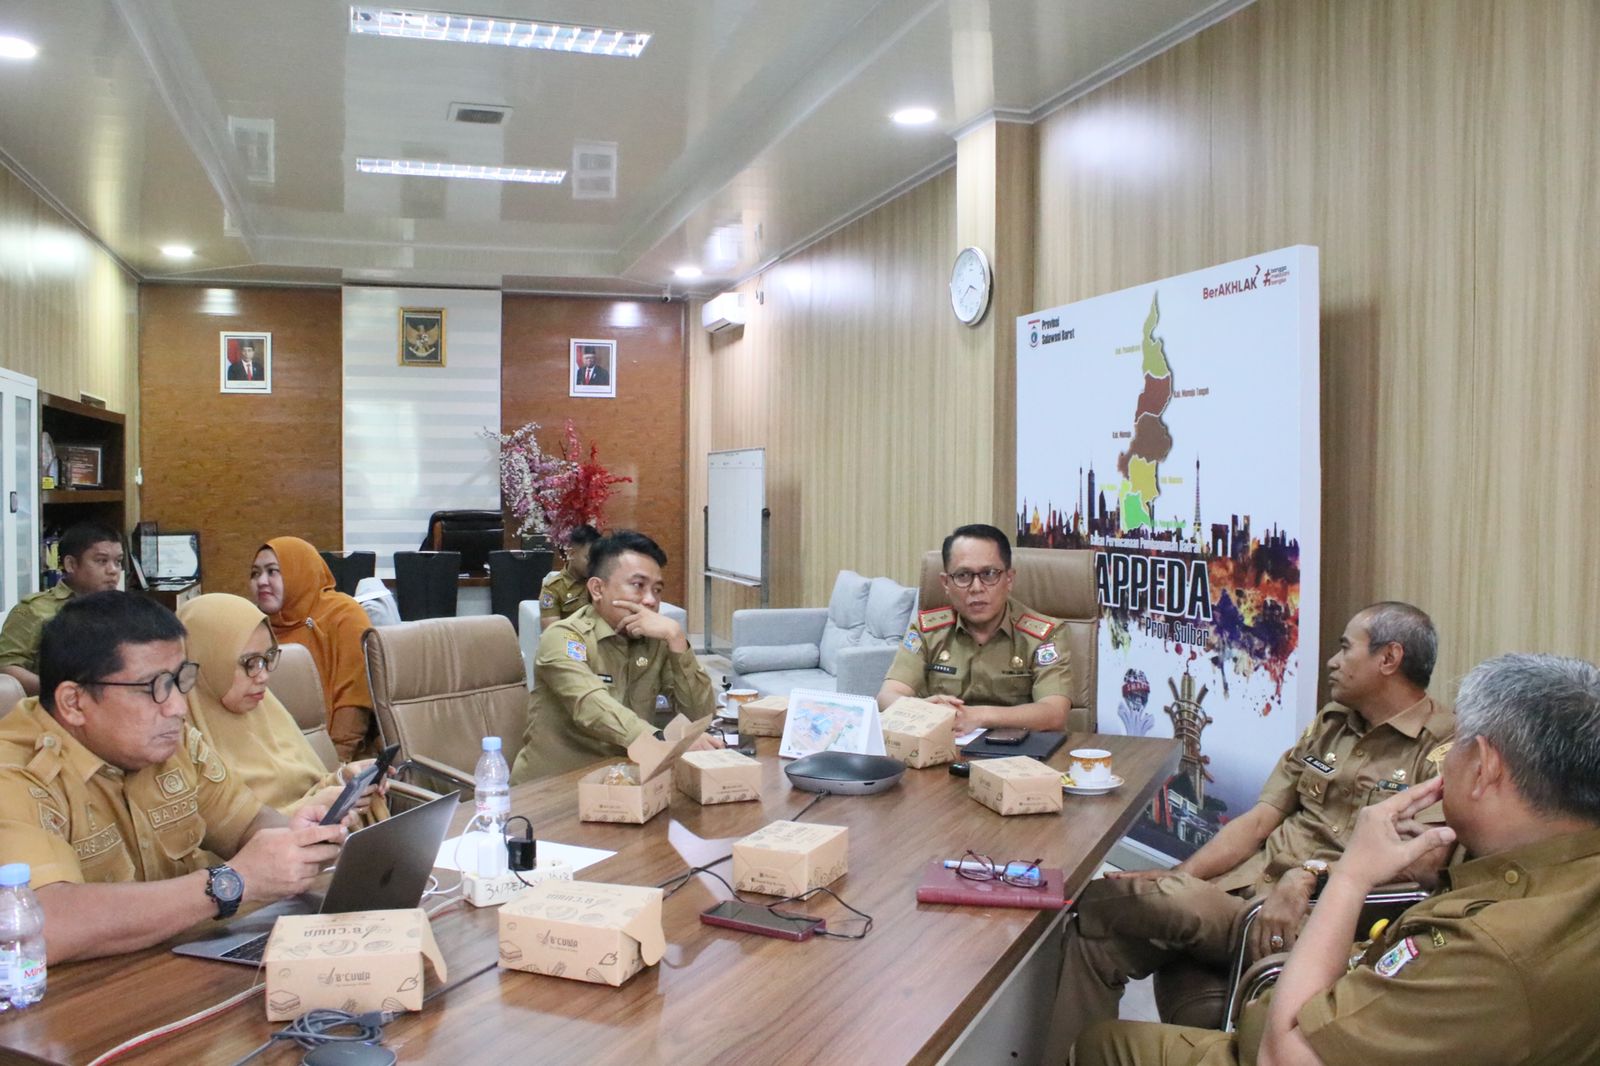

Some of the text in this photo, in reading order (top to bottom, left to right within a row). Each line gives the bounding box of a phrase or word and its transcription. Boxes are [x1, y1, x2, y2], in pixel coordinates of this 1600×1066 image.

[1203, 276, 1257, 300] BerAKHLAK
[1094, 551, 1213, 622] APPEDA
[1174, 620, 1210, 647] Sulbar
